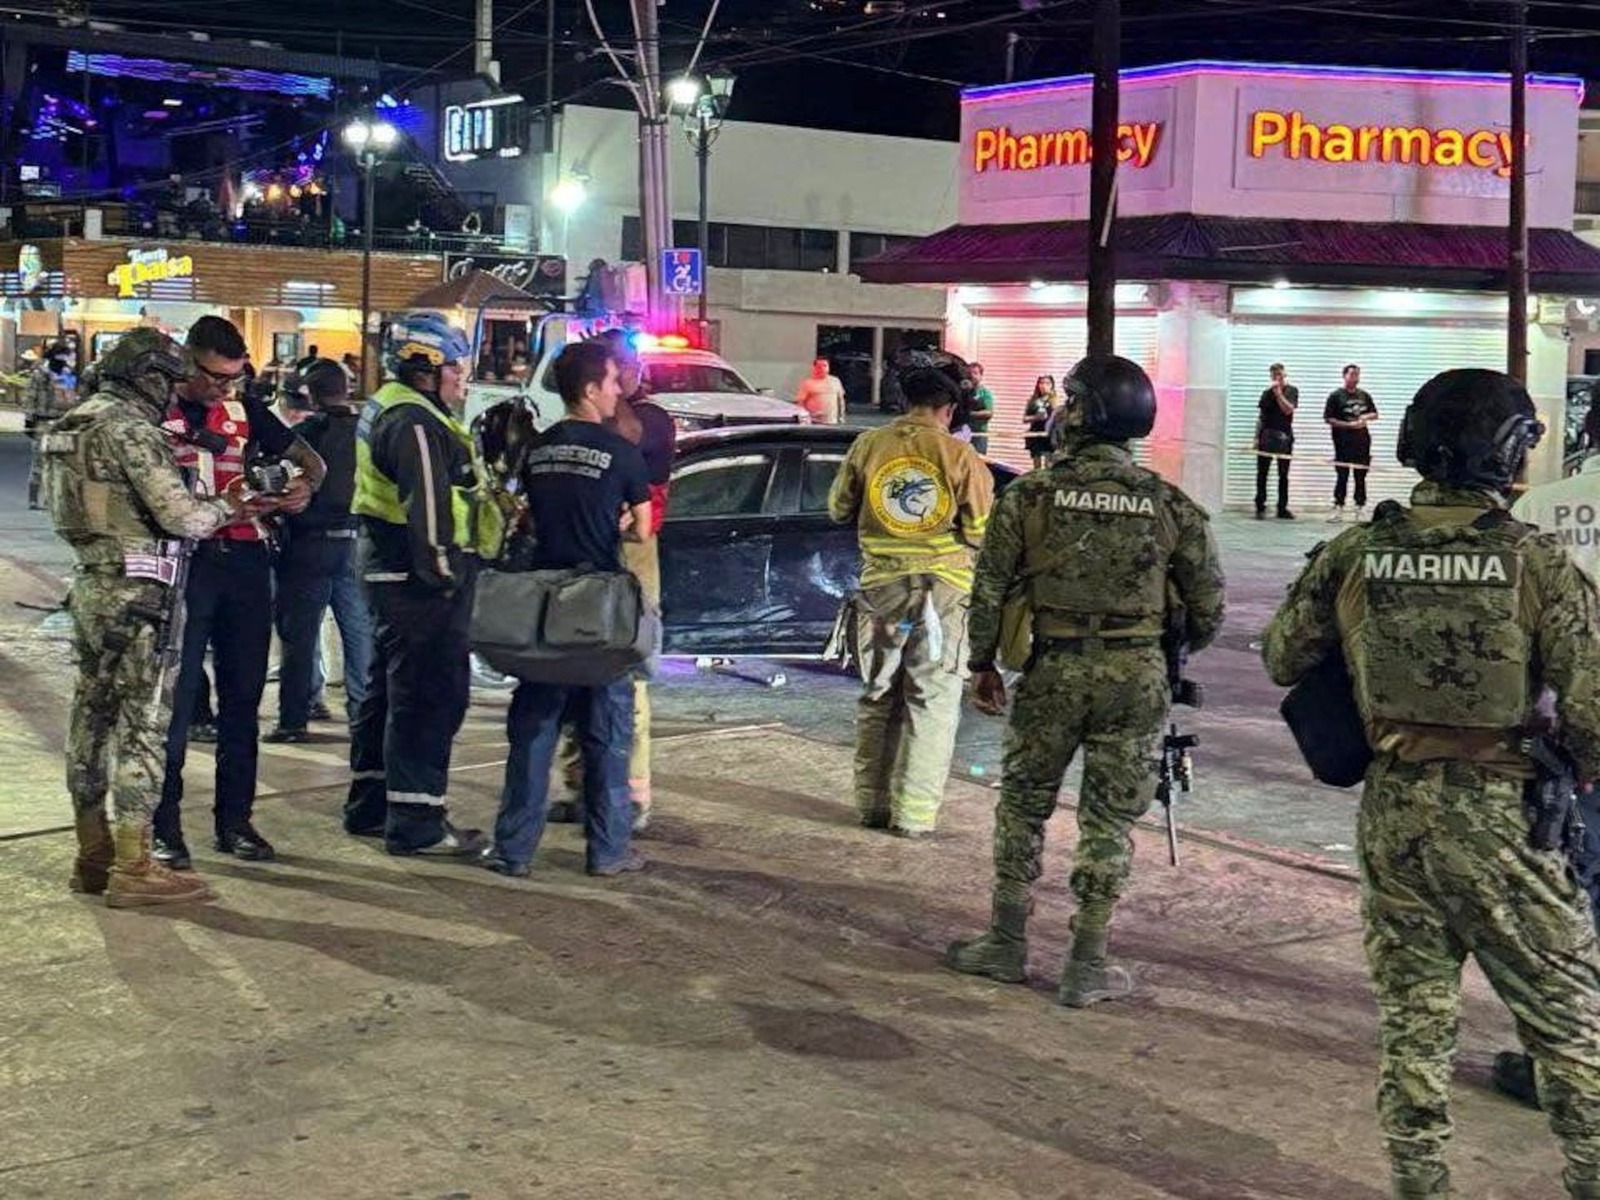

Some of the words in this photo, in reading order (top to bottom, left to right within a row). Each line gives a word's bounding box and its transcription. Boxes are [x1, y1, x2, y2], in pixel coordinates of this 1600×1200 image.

[975, 121, 1158, 173] Pharmcy
[1054, 489, 1155, 515] MARINA
[1363, 552, 1508, 582] MARINA
